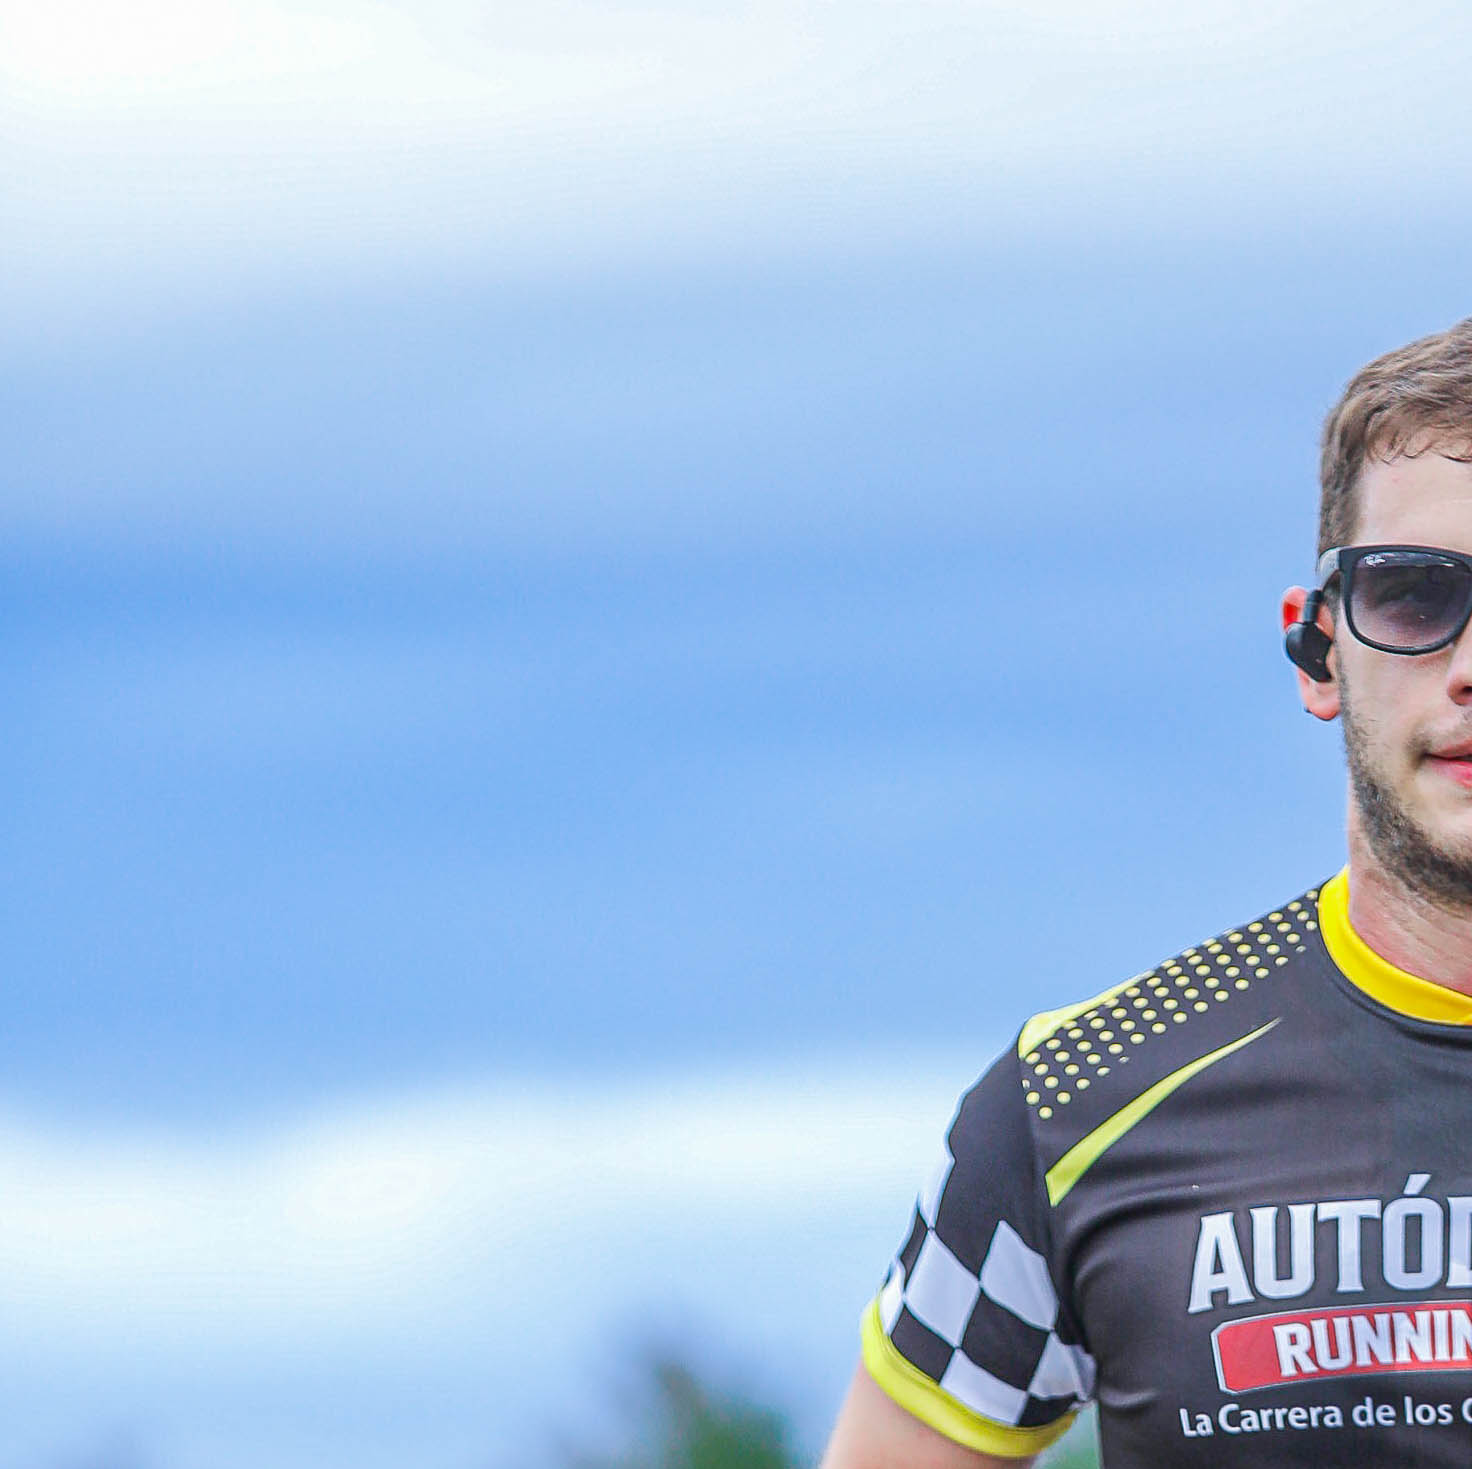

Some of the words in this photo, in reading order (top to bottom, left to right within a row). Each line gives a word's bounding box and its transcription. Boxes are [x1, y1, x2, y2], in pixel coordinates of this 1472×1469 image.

[1179, 1408, 1214, 1437] La
[1218, 1403, 1344, 1434] Carrera
[1352, 1397, 1396, 1427] de
[1404, 1396, 1453, 1425] los
